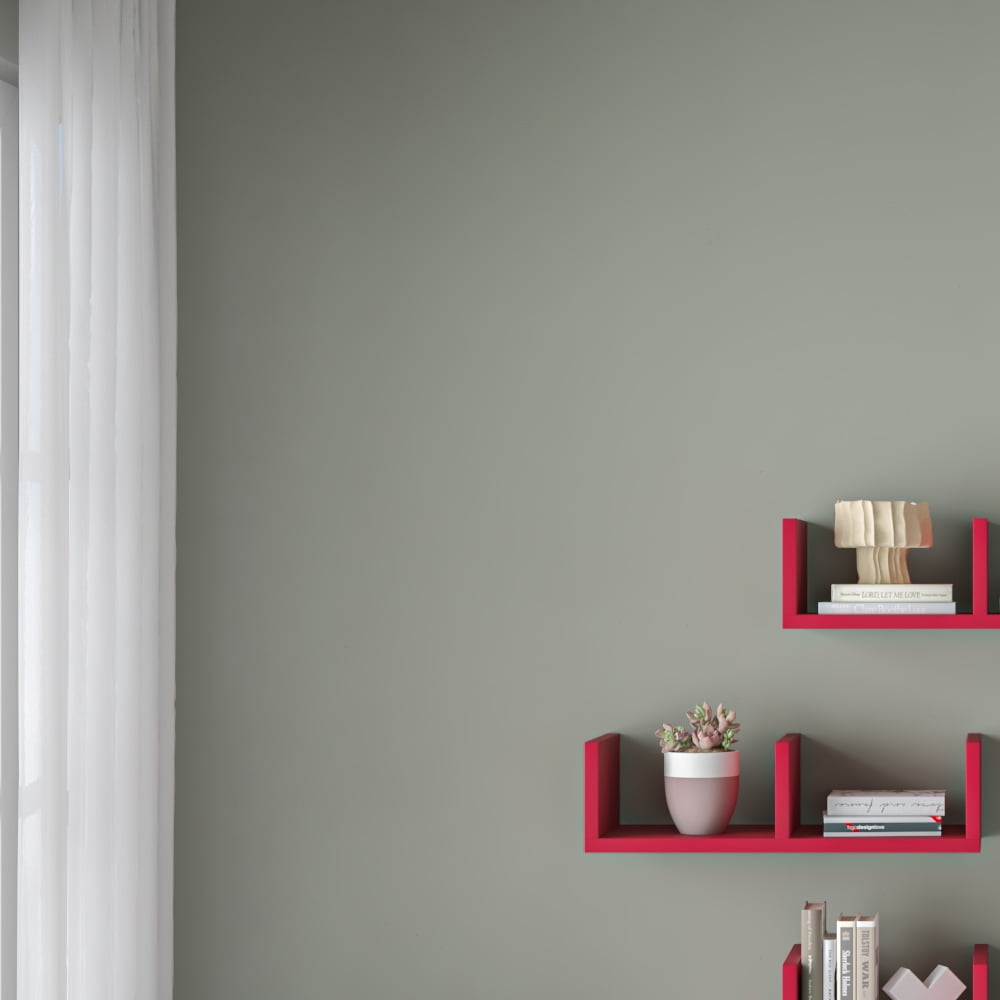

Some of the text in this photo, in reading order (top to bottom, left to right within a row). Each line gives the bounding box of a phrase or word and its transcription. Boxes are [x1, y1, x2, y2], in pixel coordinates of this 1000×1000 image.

[861, 930, 870, 957] TOLSTOY
[842, 950, 851, 997] Sherlock Holmes
[861, 961, 870, 989] WAR
